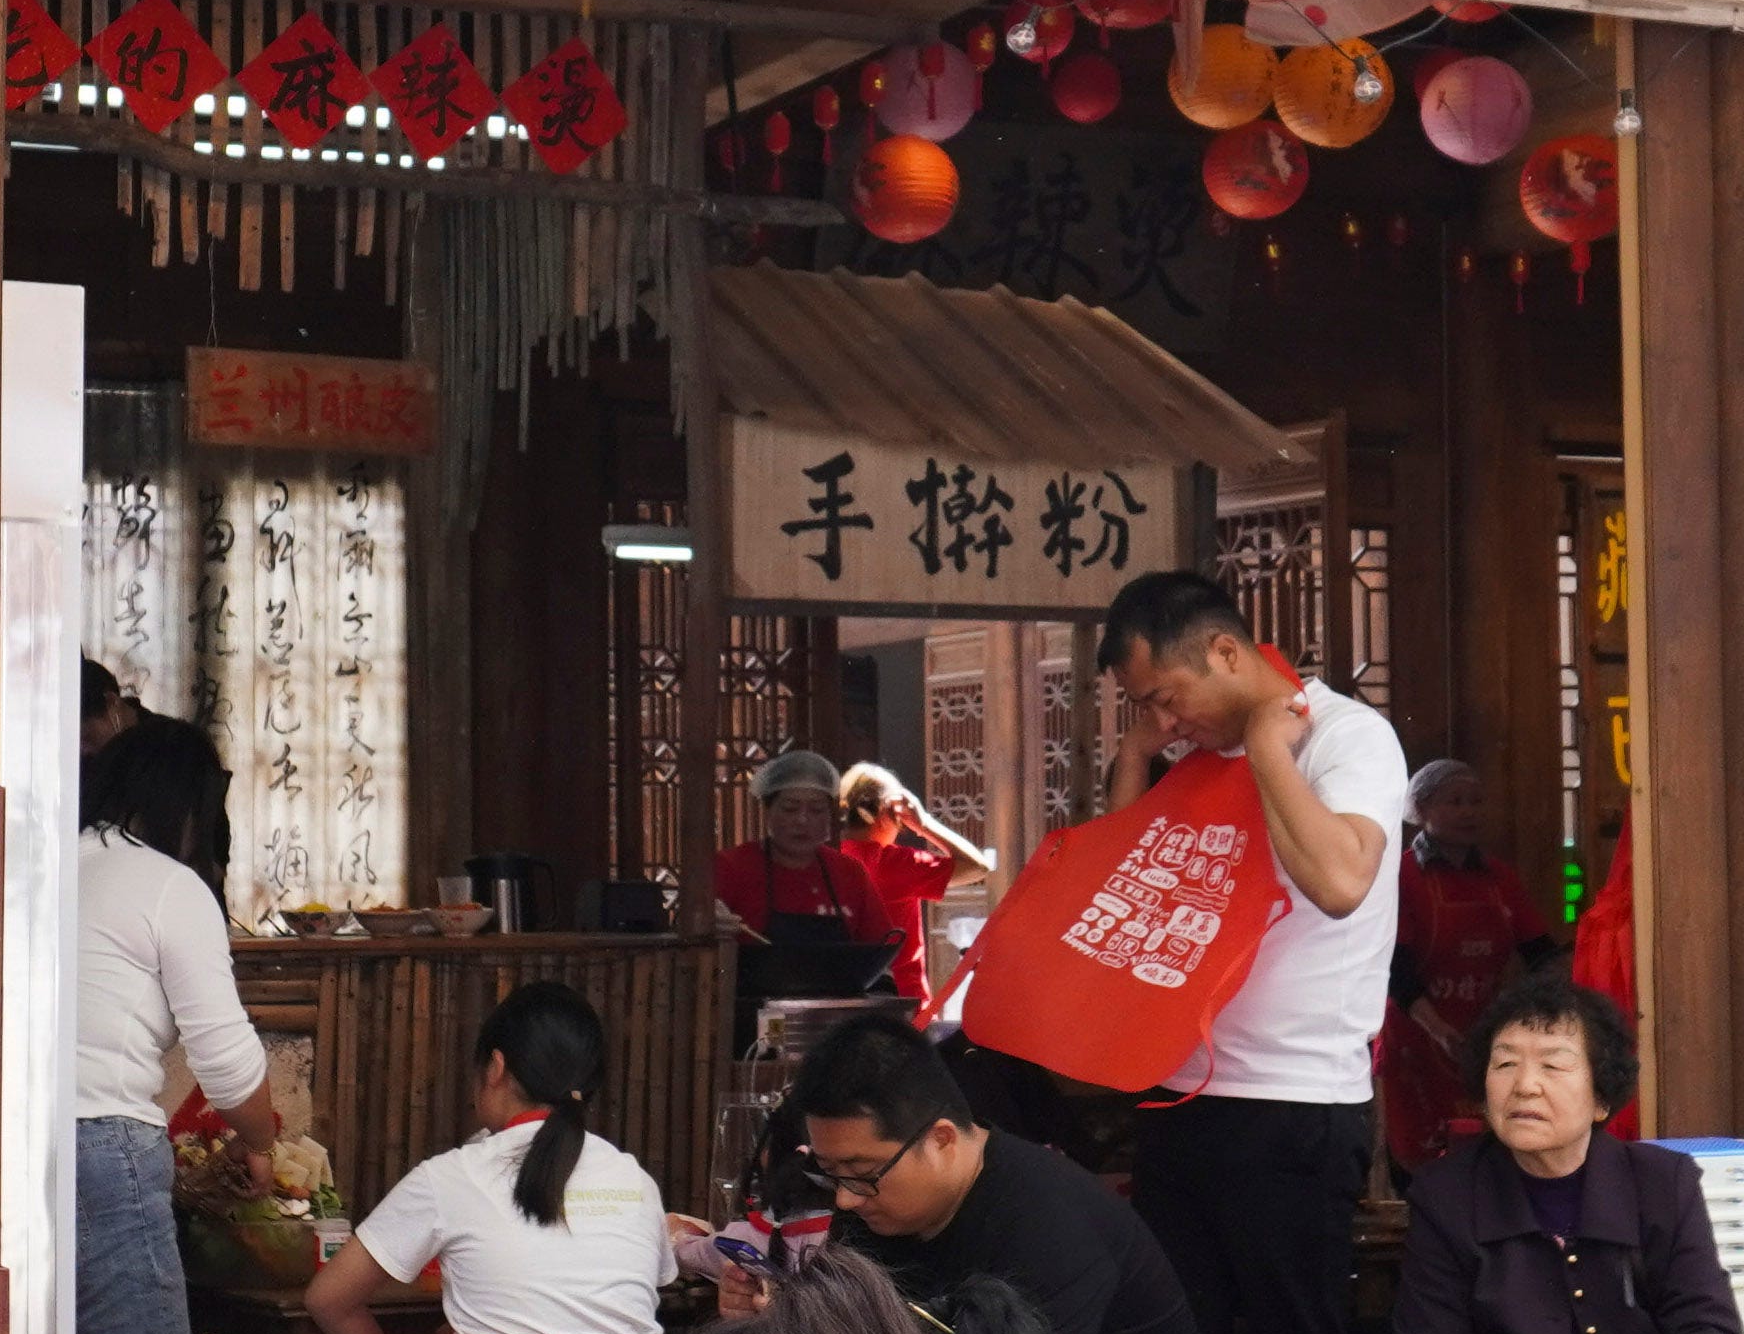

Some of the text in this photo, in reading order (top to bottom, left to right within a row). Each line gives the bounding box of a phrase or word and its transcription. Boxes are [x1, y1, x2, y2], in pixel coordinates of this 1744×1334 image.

[781, 451, 1146, 580] 手擀粉
[1117, 816, 1168, 877] 大吉大利
